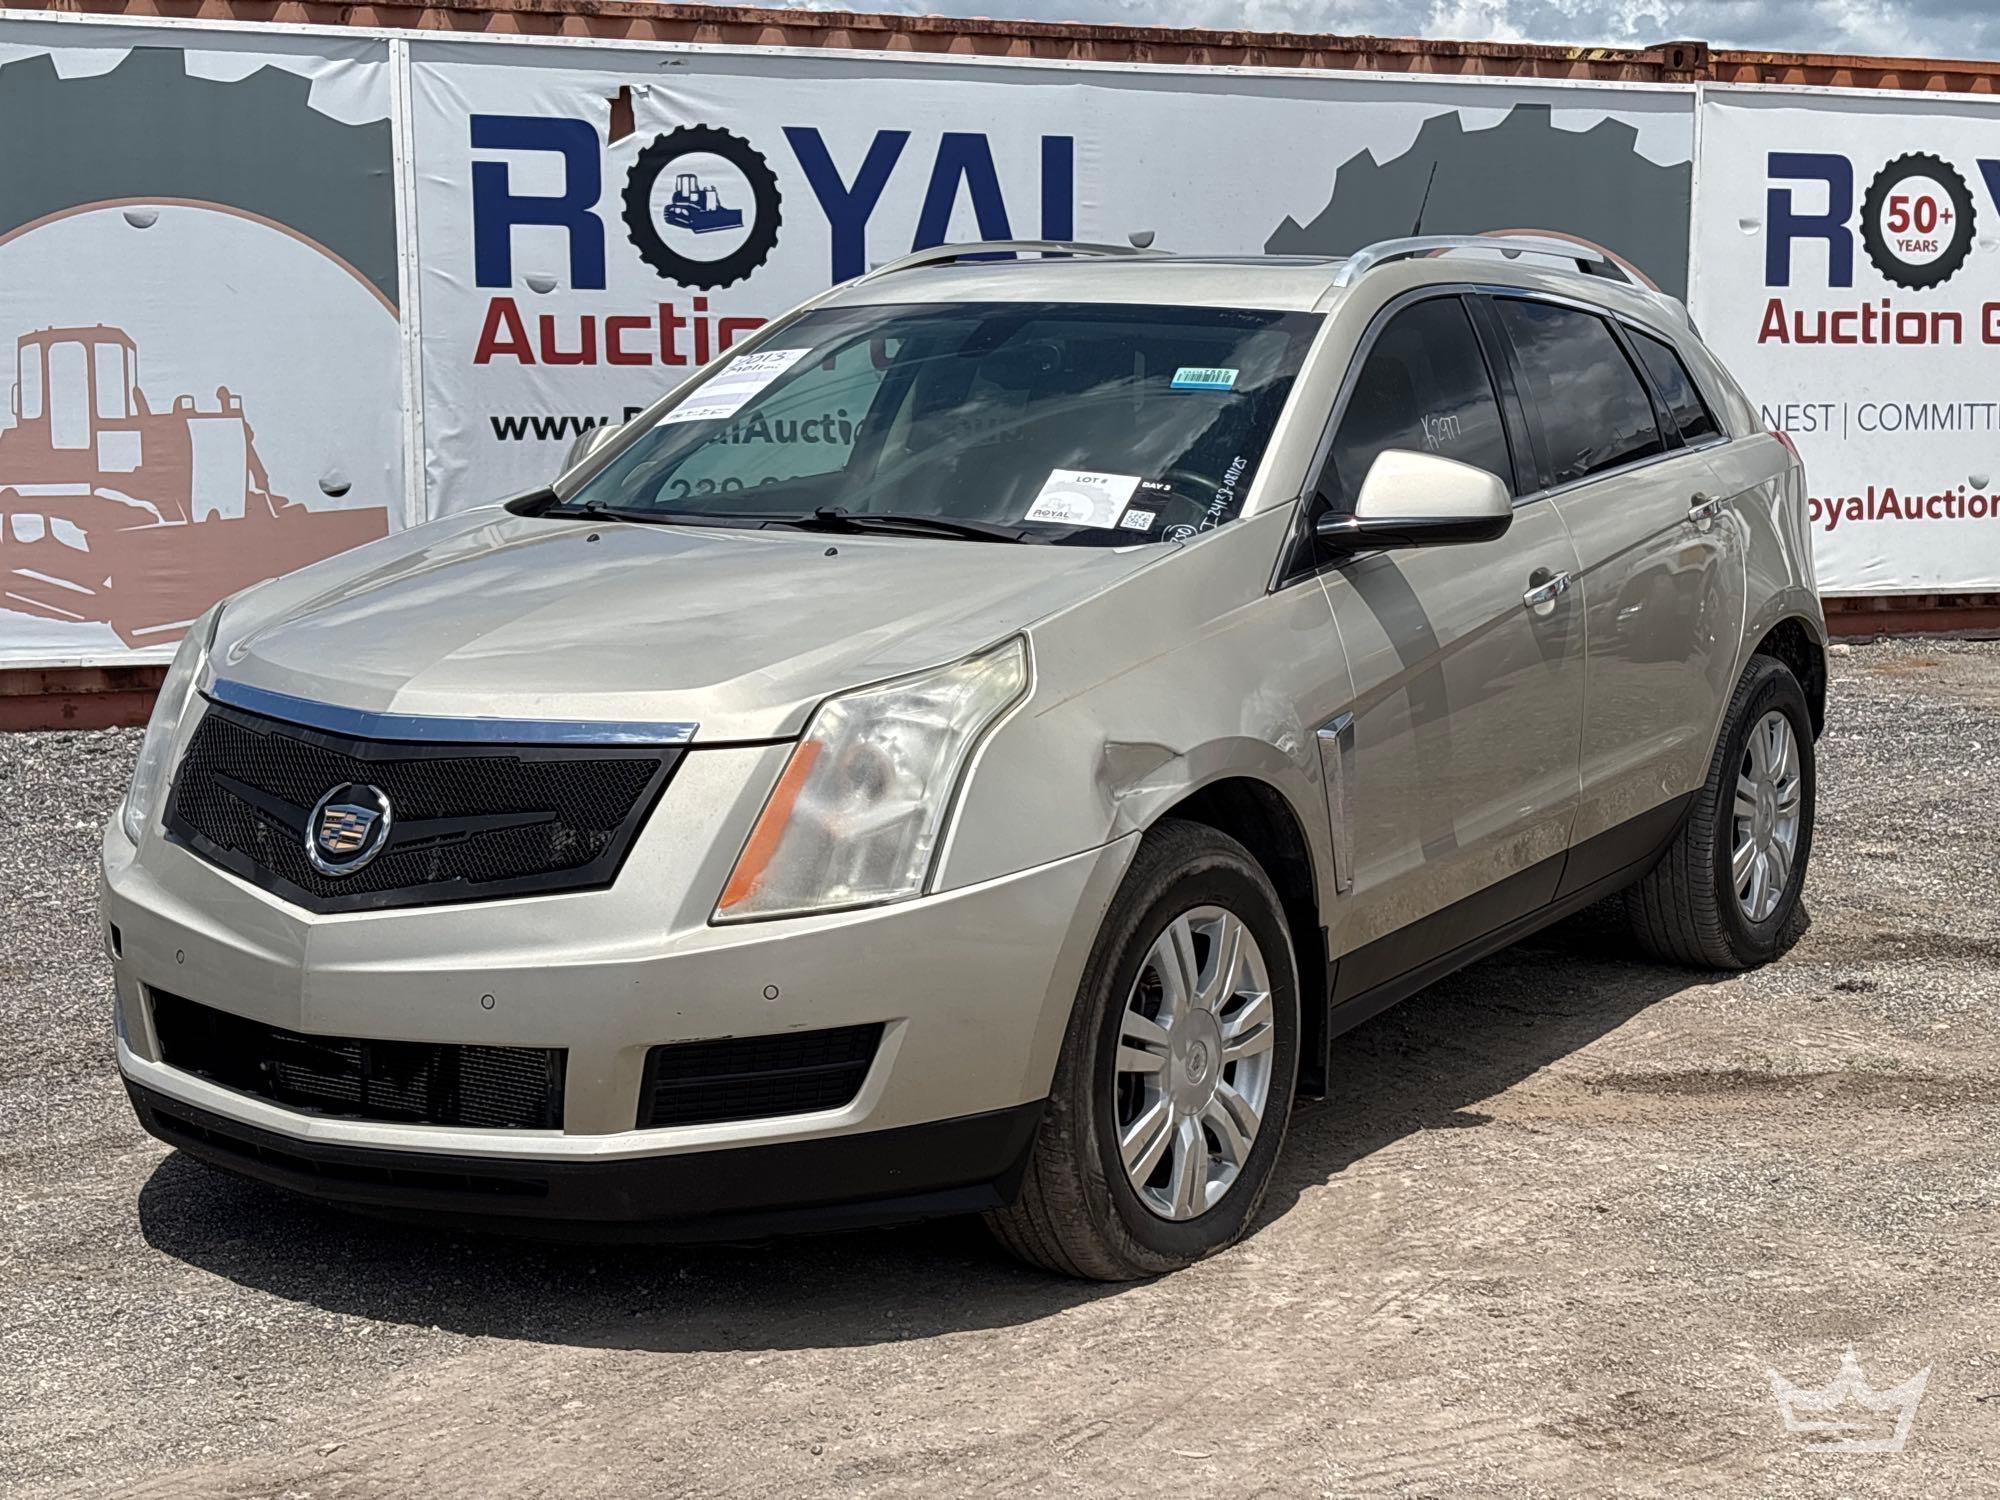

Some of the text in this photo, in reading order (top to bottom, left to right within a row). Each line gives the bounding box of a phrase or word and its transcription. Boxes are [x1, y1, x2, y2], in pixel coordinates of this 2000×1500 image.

[1887, 195, 1953, 234] 50+
[1896, 239, 1939, 253] YEARS
[1757, 298, 1962, 345] Auction
[1857, 402, 2000, 432] COMMITT
[1076, 475, 1100, 484] LOT
[1141, 481, 1163, 490] DAY
[1032, 508, 1070, 518] ROYAL
